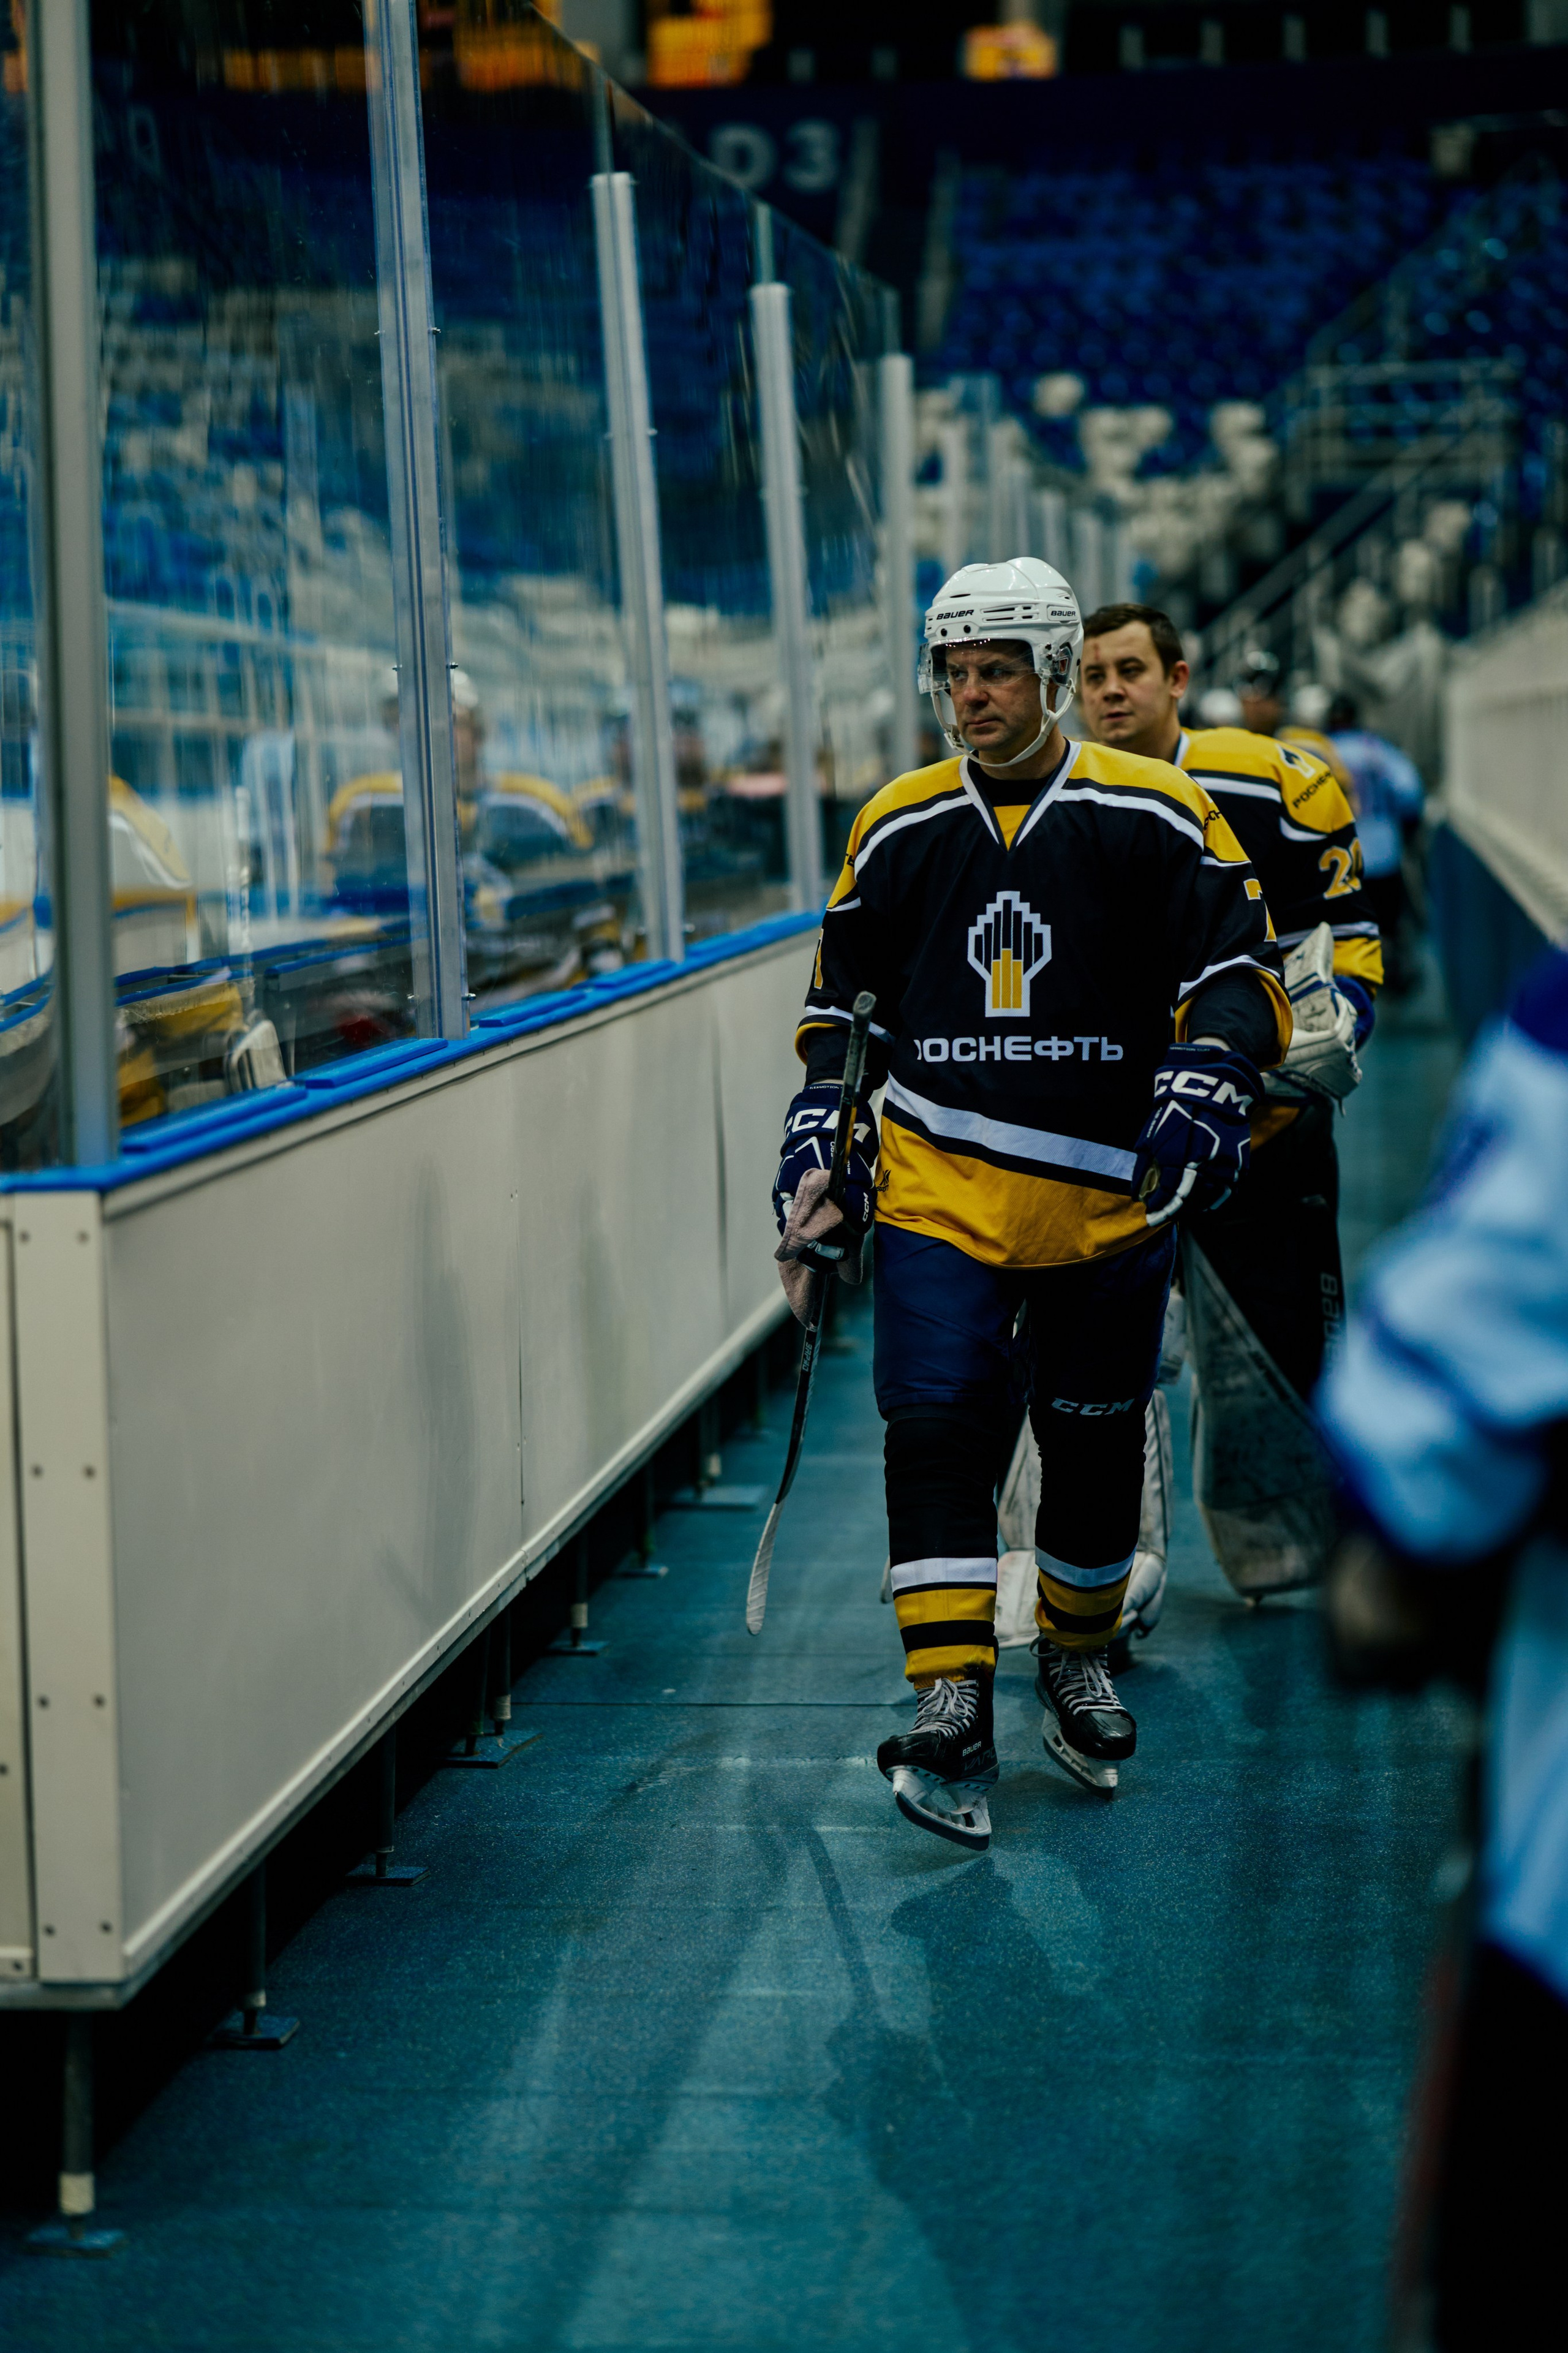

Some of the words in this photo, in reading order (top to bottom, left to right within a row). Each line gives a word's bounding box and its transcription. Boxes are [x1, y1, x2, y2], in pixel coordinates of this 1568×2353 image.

[936, 609, 974, 620] BAUER
[1155, 1071, 1254, 1116] CCM
[1051, 1397, 1135, 1416] CCM
[962, 1740, 982, 1758] BAUER
